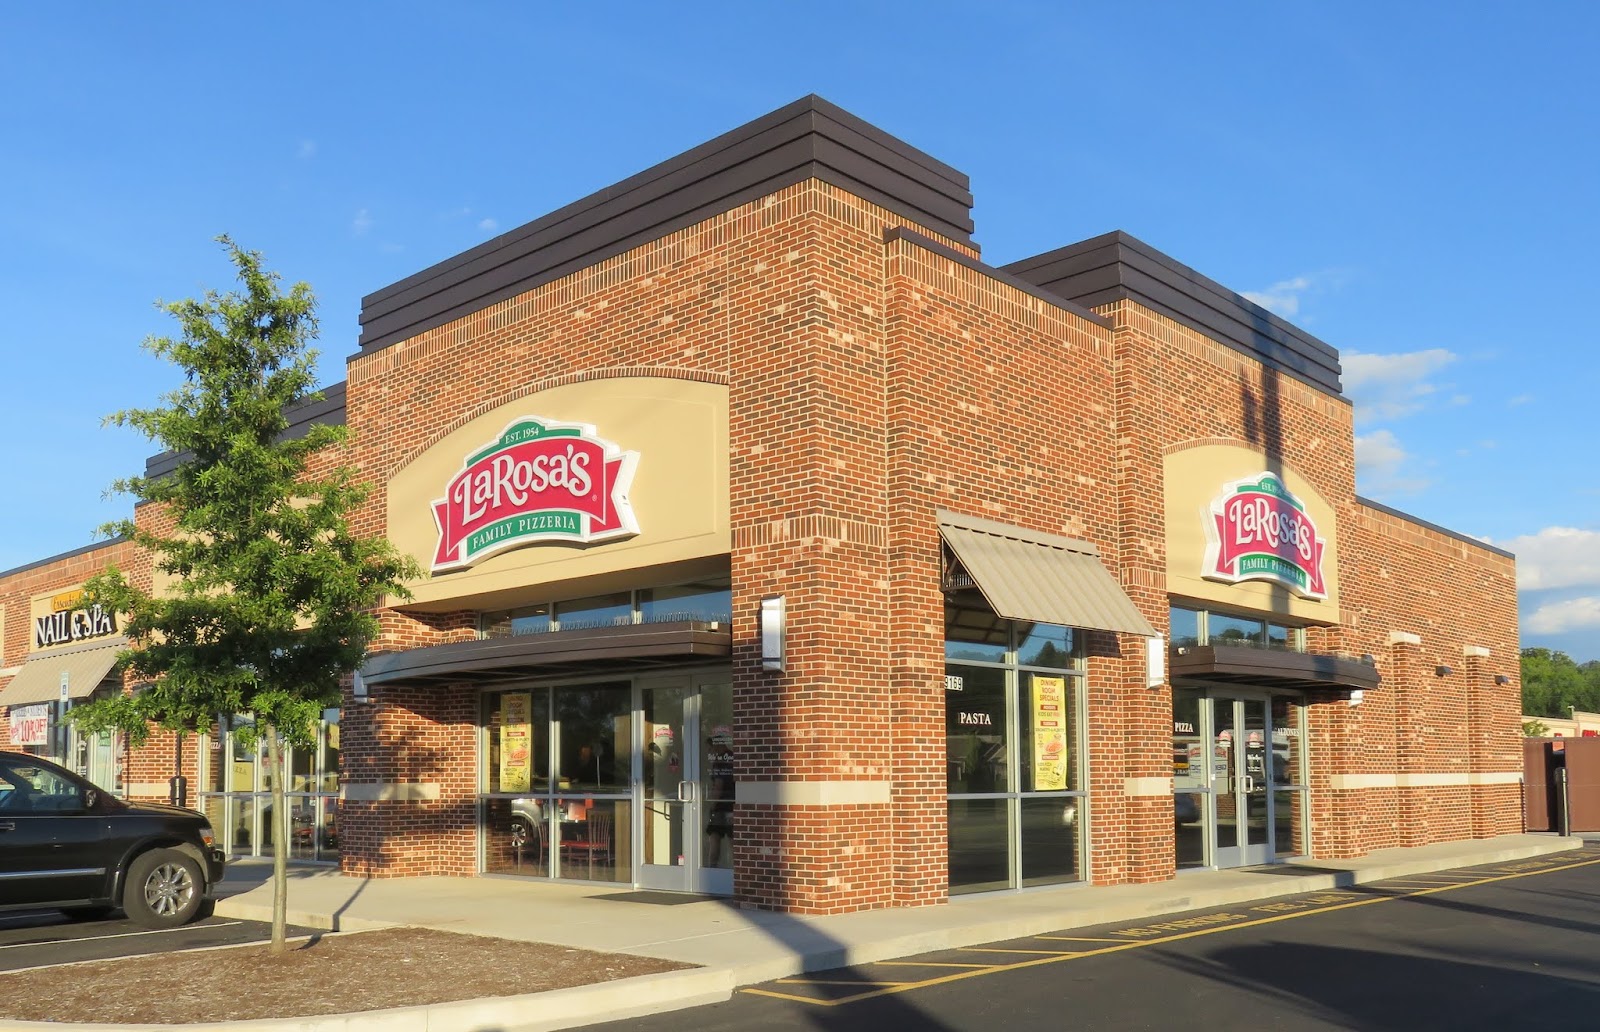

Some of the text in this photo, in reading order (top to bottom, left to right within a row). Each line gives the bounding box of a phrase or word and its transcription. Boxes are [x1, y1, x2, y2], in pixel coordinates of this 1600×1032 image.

[504, 426, 540, 445] EST. 1954
[453, 444, 592, 526] LaRosa's
[472, 514, 576, 550] FAMILY PIZZERIA
[1229, 497, 1312, 561] LaRosa's
[1242, 557, 1304, 584] FAMILY PIZZERIA
[35, 604, 113, 646] NAIL & SPA
[1040, 679, 1057, 687] DINING
[1039, 694, 1059, 702] SPECIALS
[960, 712, 991, 725] PASTA
[1174, 722, 1194, 733] PIZZA
